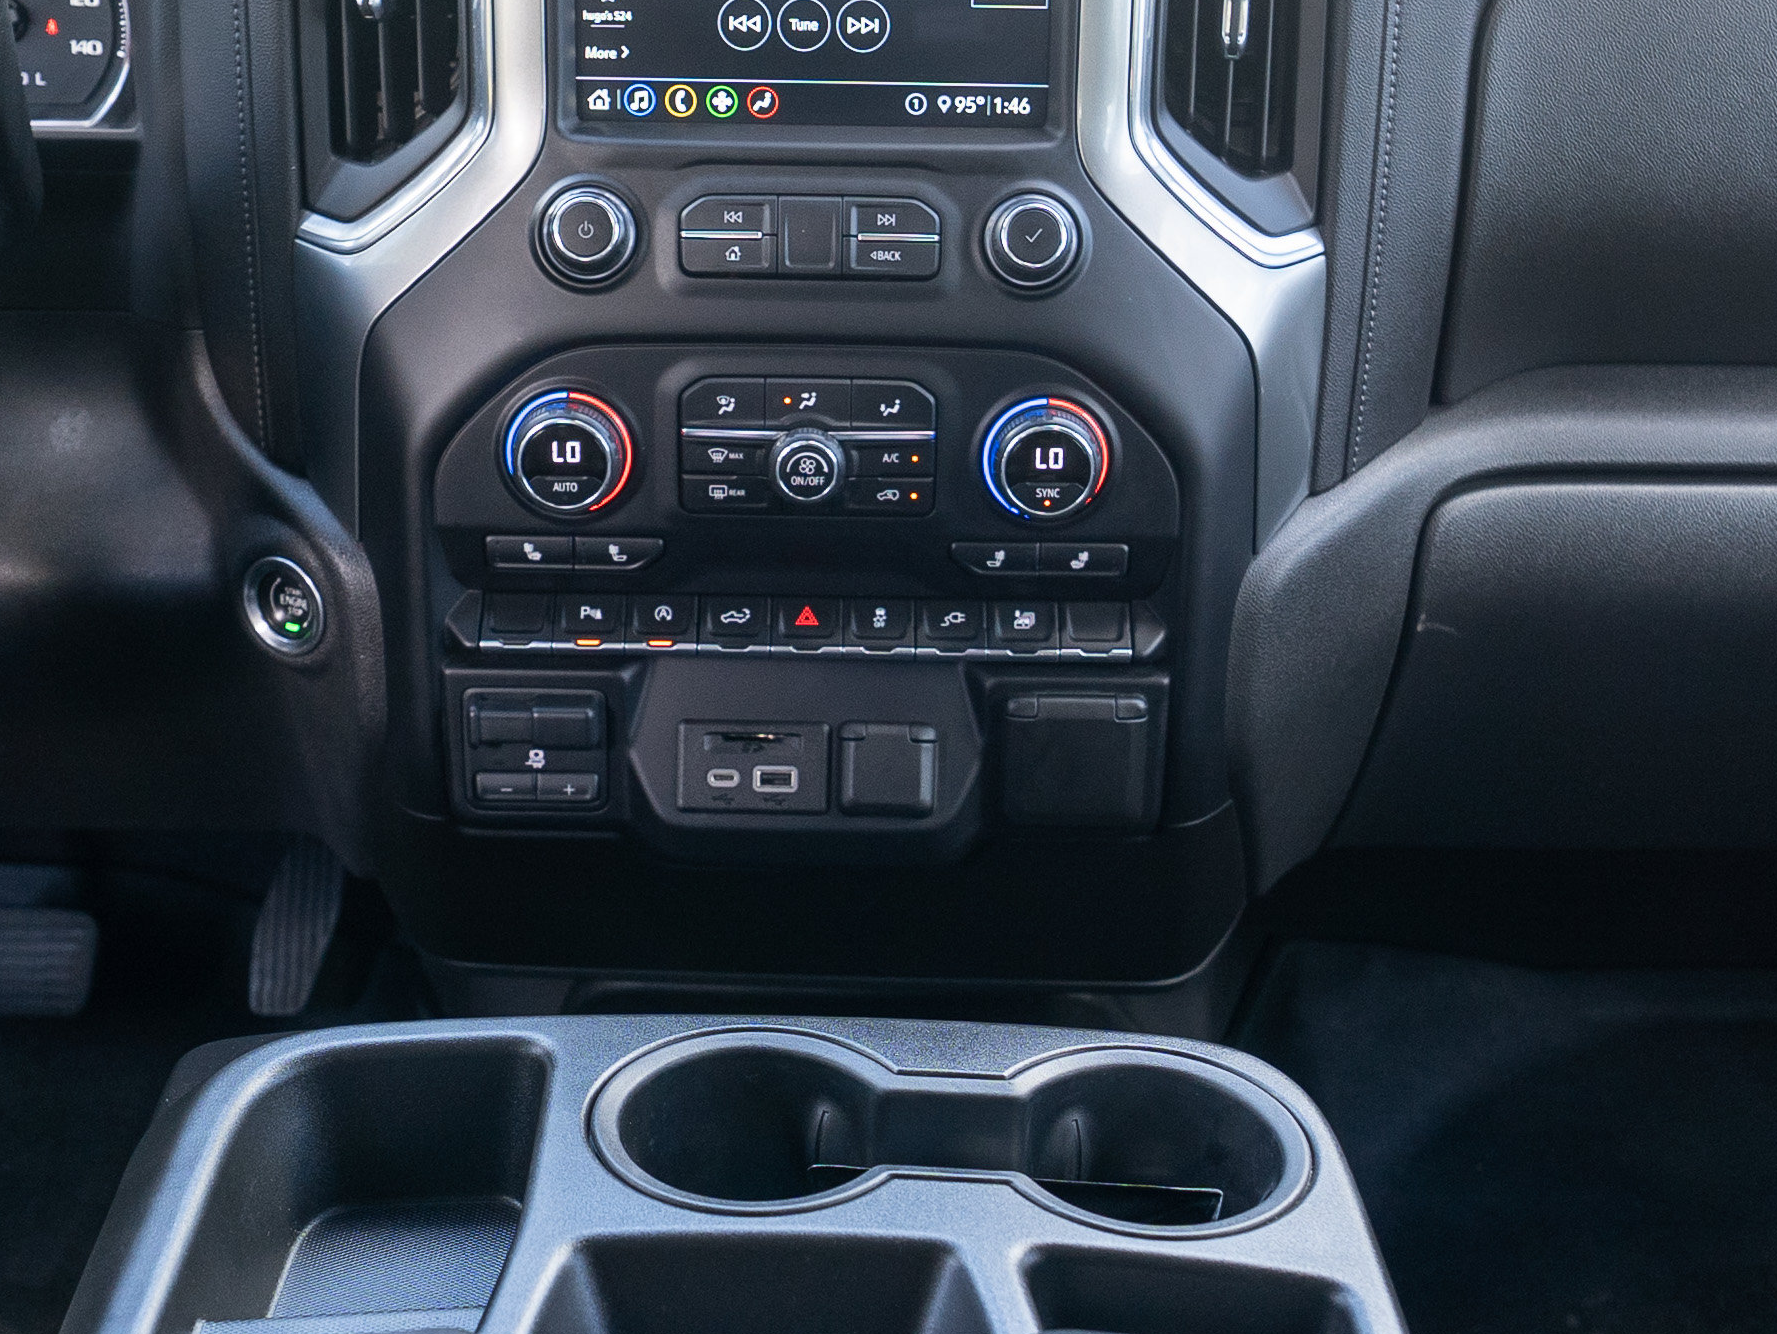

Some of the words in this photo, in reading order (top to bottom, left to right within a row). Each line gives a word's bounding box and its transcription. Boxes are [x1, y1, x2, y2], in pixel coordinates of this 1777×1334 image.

[613, 10, 633, 22] S24
[788, 17, 820, 32] Tune
[69, 39, 104, 56] 140
[584, 45, 618, 60] More
[993, 96, 1032, 115] 1:46
[877, 250, 902, 262] BACK
[551, 440, 582, 463] LO
[728, 451, 744, 461] MAX
[882, 452, 900, 464] A/C
[1035, 447, 1064, 470] LO
[552, 481, 578, 493] AUTO
[790, 475, 826, 487] ON/OFF
[729, 488, 746, 498] REAR
[1035, 487, 1061, 499] SYNC
